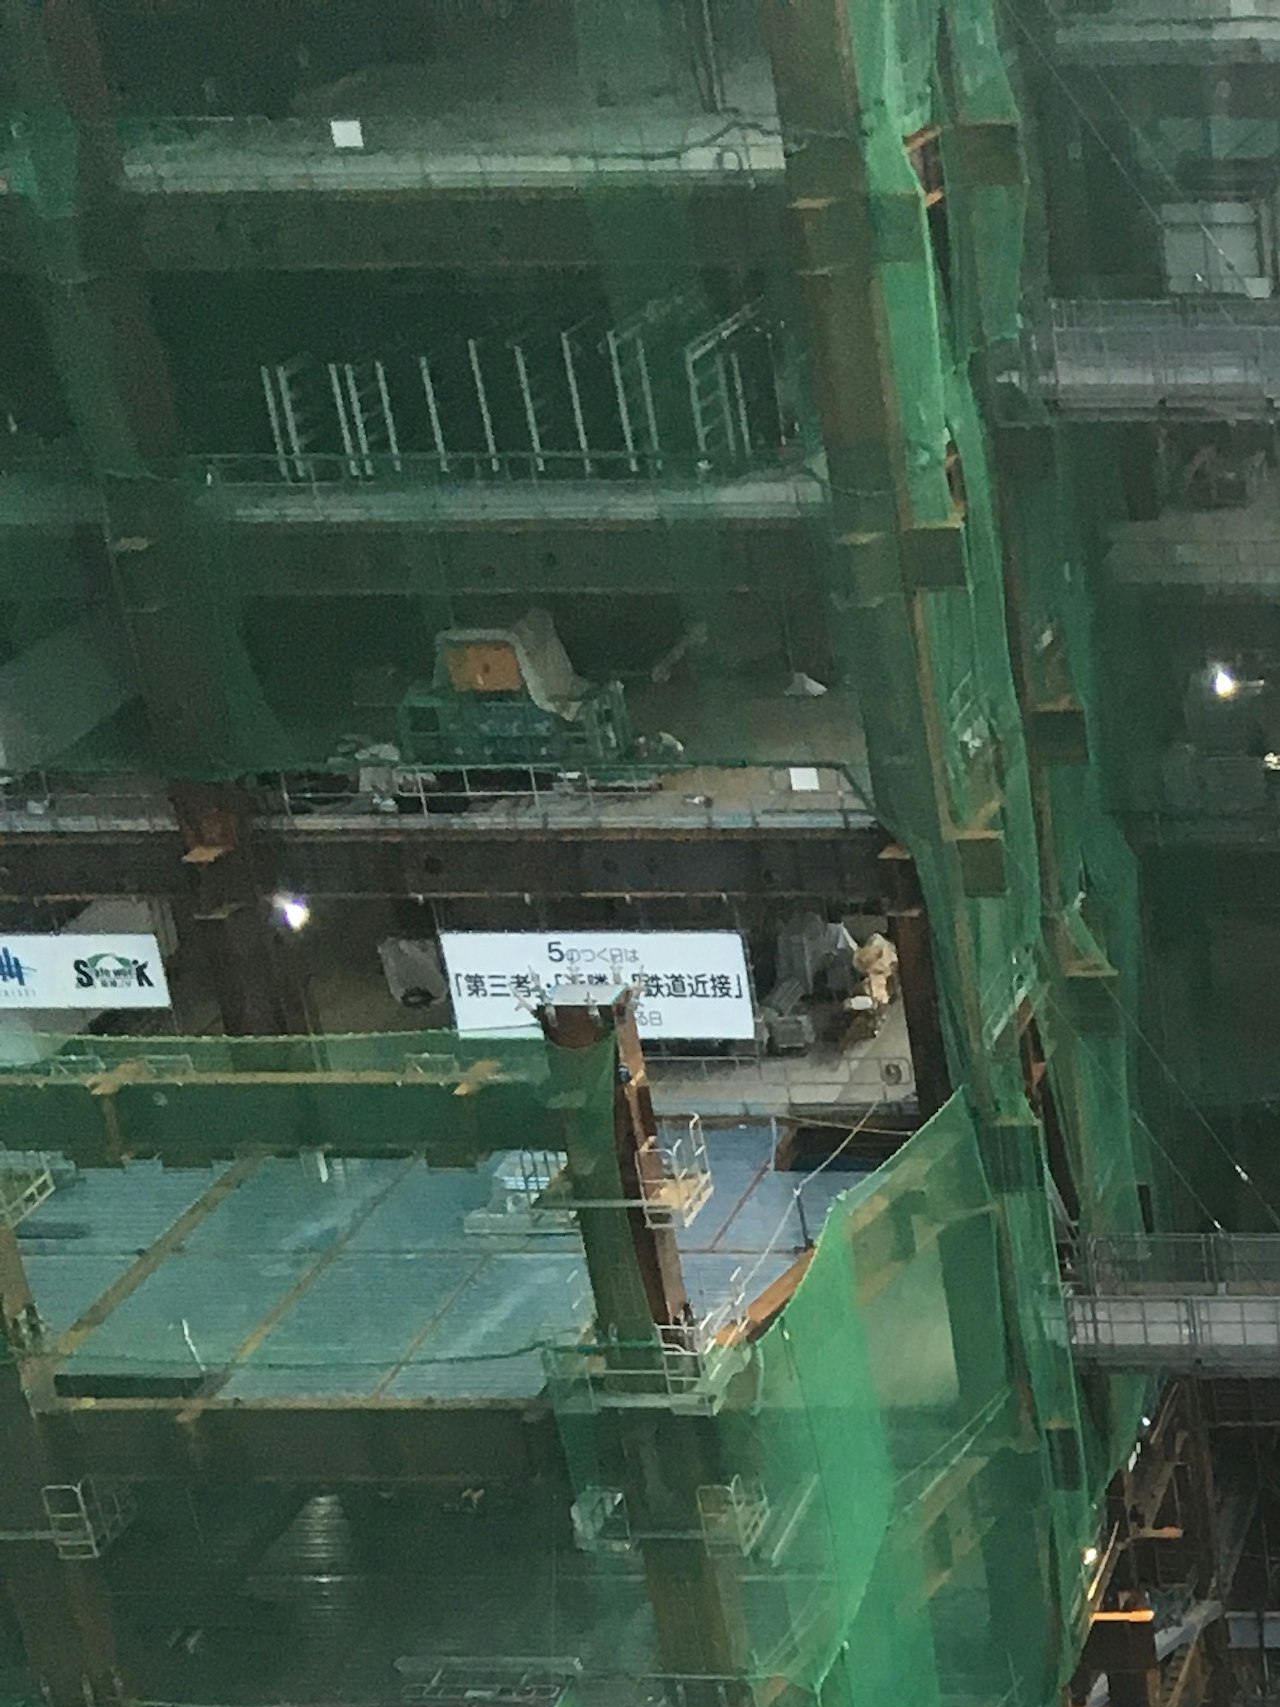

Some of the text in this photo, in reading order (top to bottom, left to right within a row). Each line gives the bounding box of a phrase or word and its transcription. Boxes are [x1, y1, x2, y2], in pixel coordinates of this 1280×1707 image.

[547, 941, 641, 964] 5のつく日は
